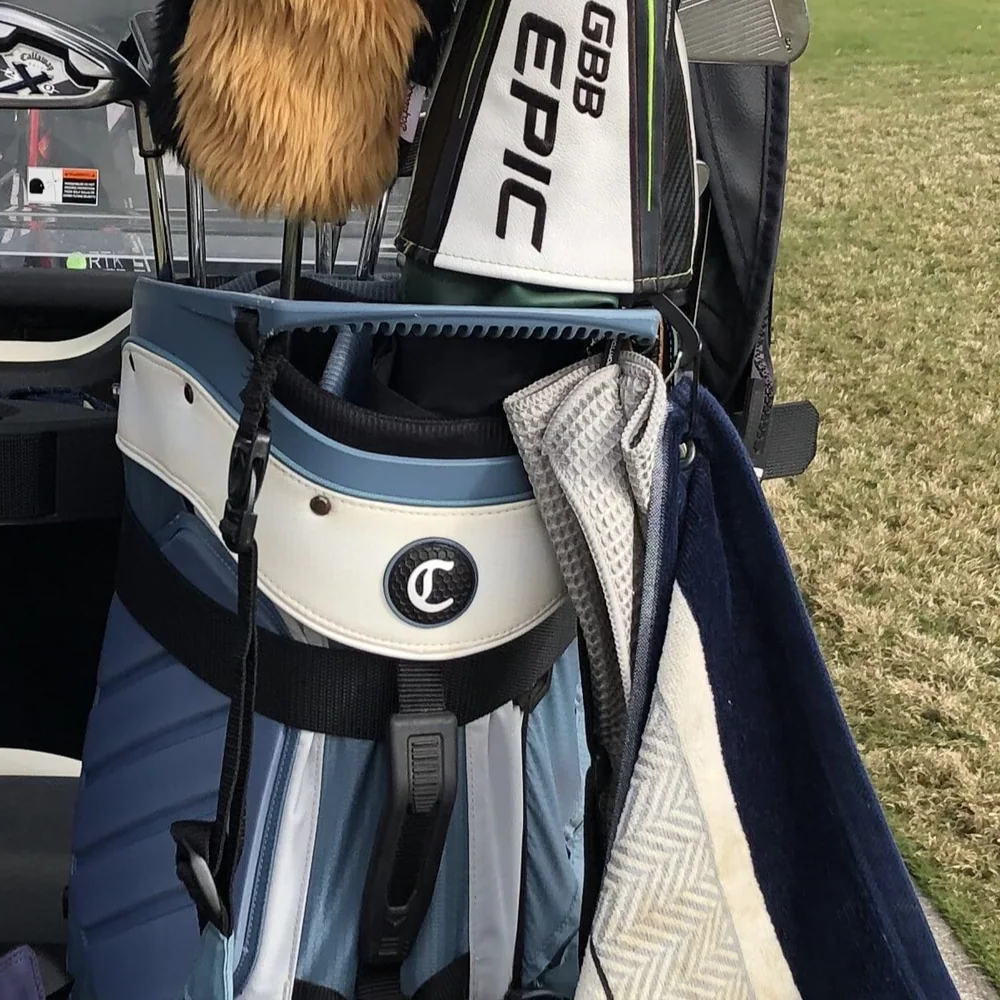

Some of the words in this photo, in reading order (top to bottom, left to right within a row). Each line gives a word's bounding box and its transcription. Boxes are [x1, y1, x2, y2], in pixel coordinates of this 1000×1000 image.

[20, 51, 55, 72] Callaway
[572, 0, 616, 119] GBB
[495, 11, 567, 254] EPIC
[407, 559, 455, 613] C
